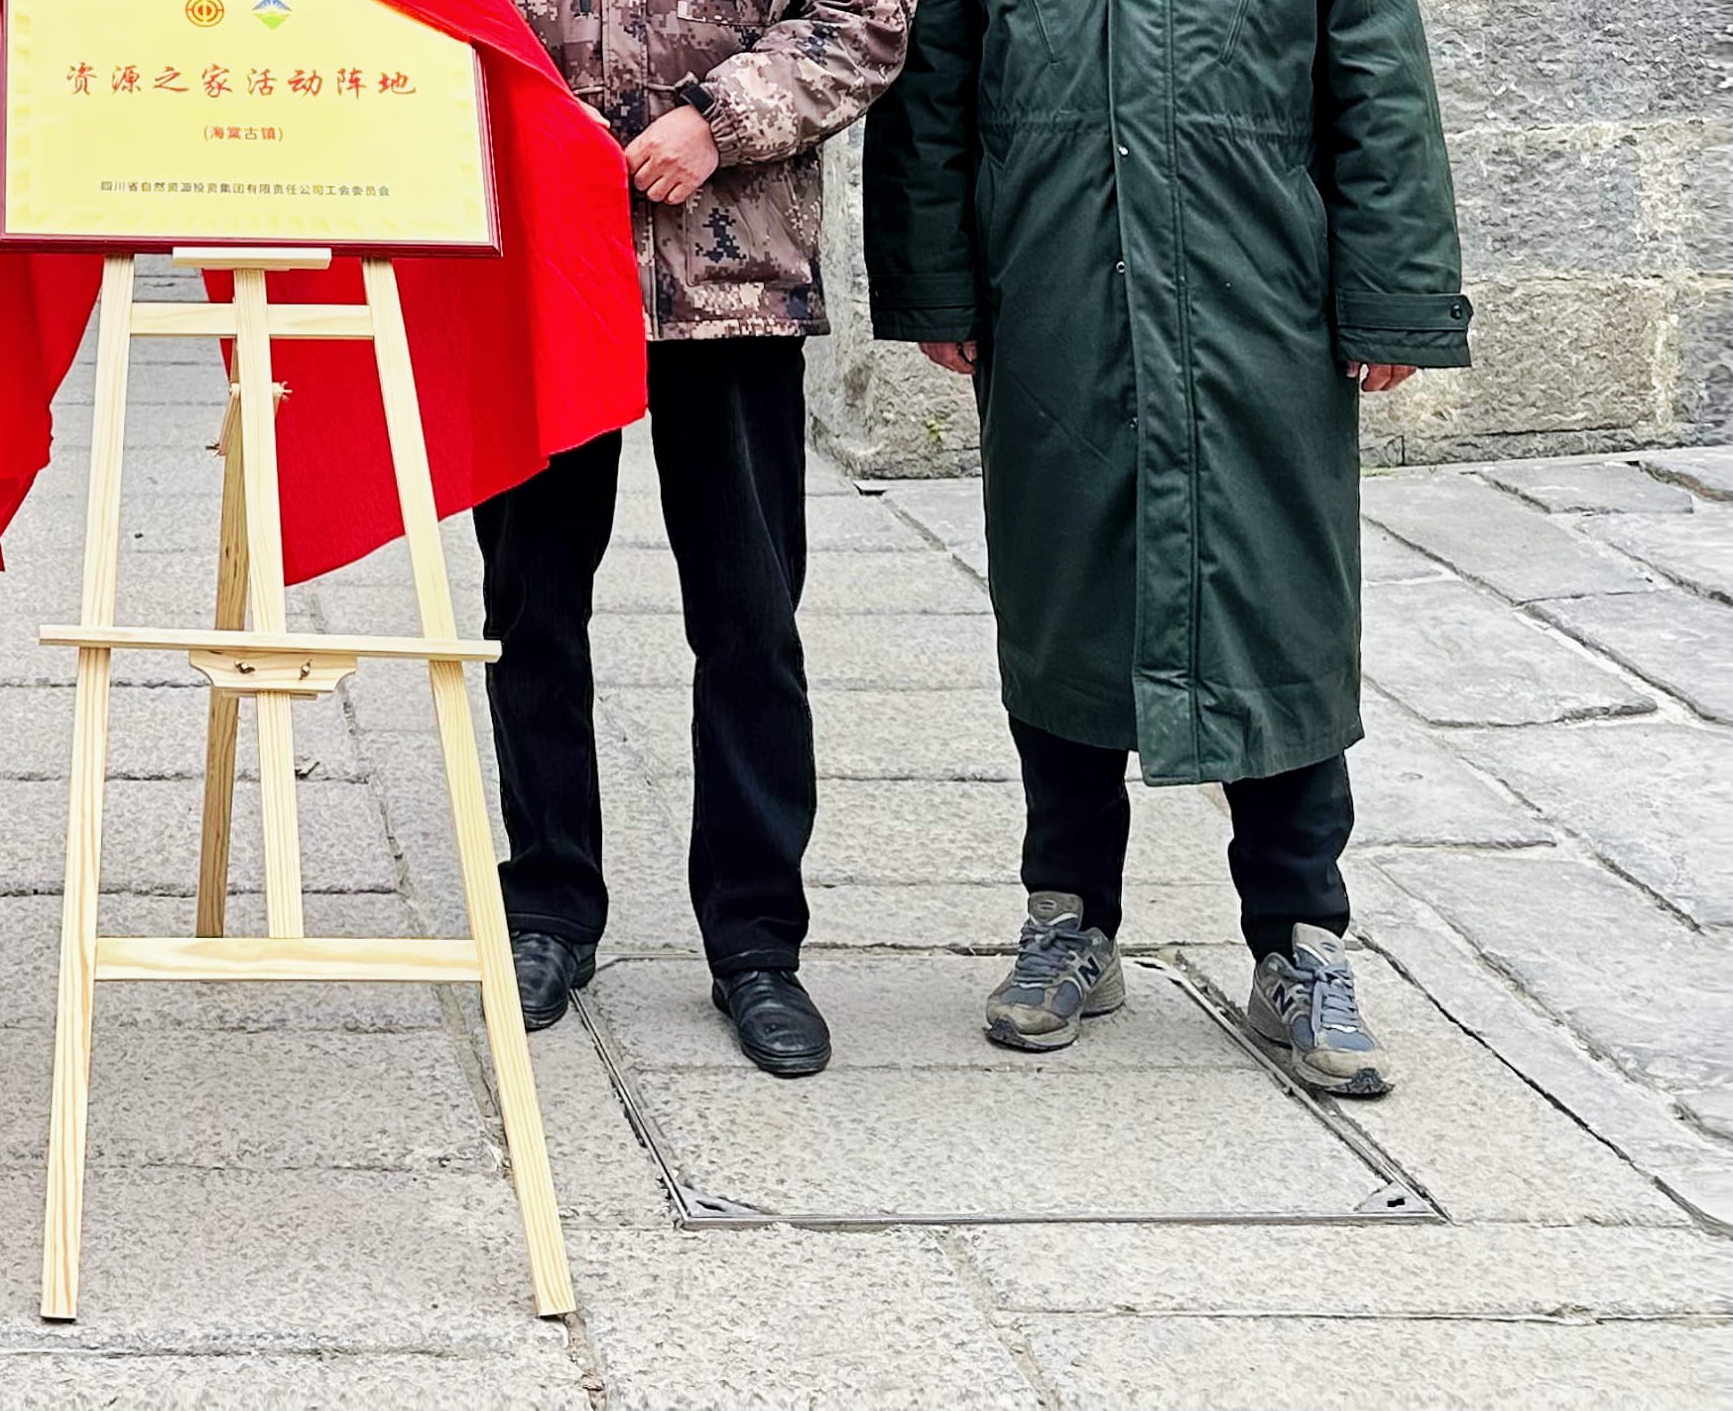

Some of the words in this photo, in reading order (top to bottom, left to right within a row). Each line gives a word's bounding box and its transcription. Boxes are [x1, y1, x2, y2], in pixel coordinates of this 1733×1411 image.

[65, 63, 419, 101] 资源之家活动阵地
[100, 180, 391, 197] 四川省自然资源投资集团有限责任公司工会委员会
